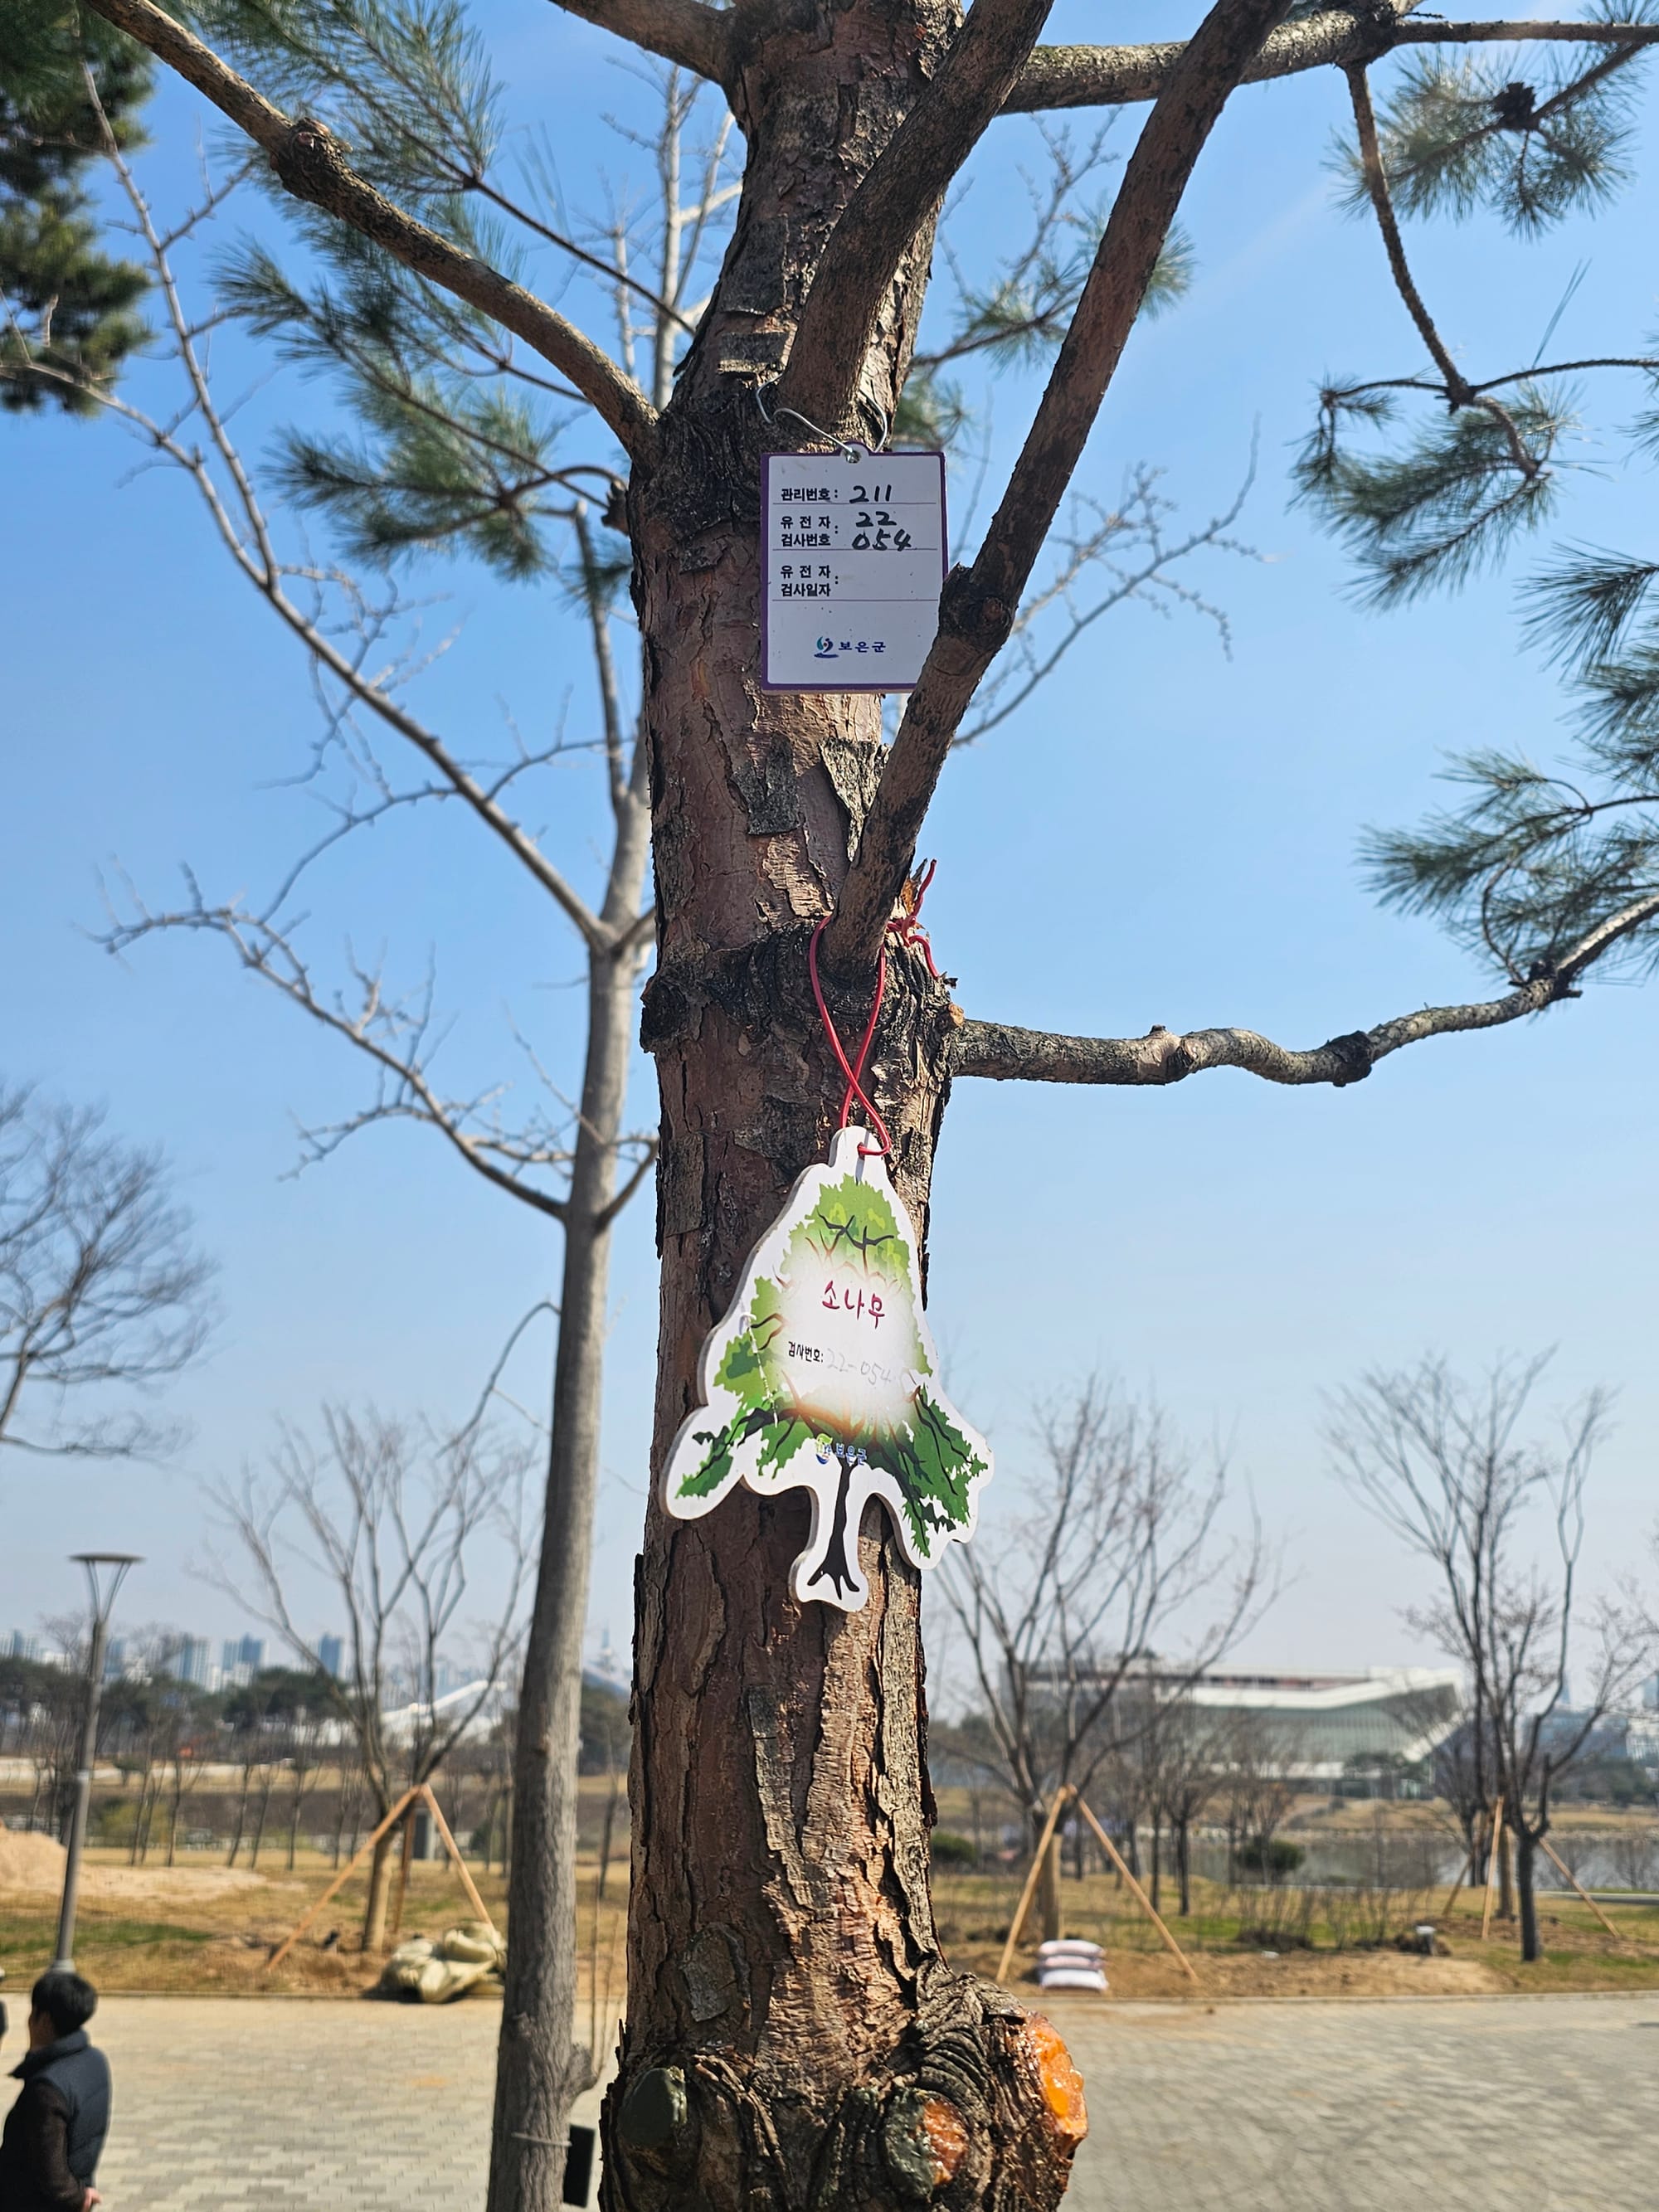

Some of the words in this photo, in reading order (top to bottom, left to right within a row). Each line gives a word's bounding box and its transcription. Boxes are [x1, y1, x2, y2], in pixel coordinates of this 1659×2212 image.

[849, 484, 892, 504] 211
[855, 511, 897, 527] 22
[781, 533, 831, 547] 검사번호
[851, 528, 912, 552] 054
[781, 583, 831, 597] 검사일자
[838, 640, 886, 653] 보은군
[822, 1280, 885, 1330] 소나무
[827, 1348, 892, 1385] 22-054
